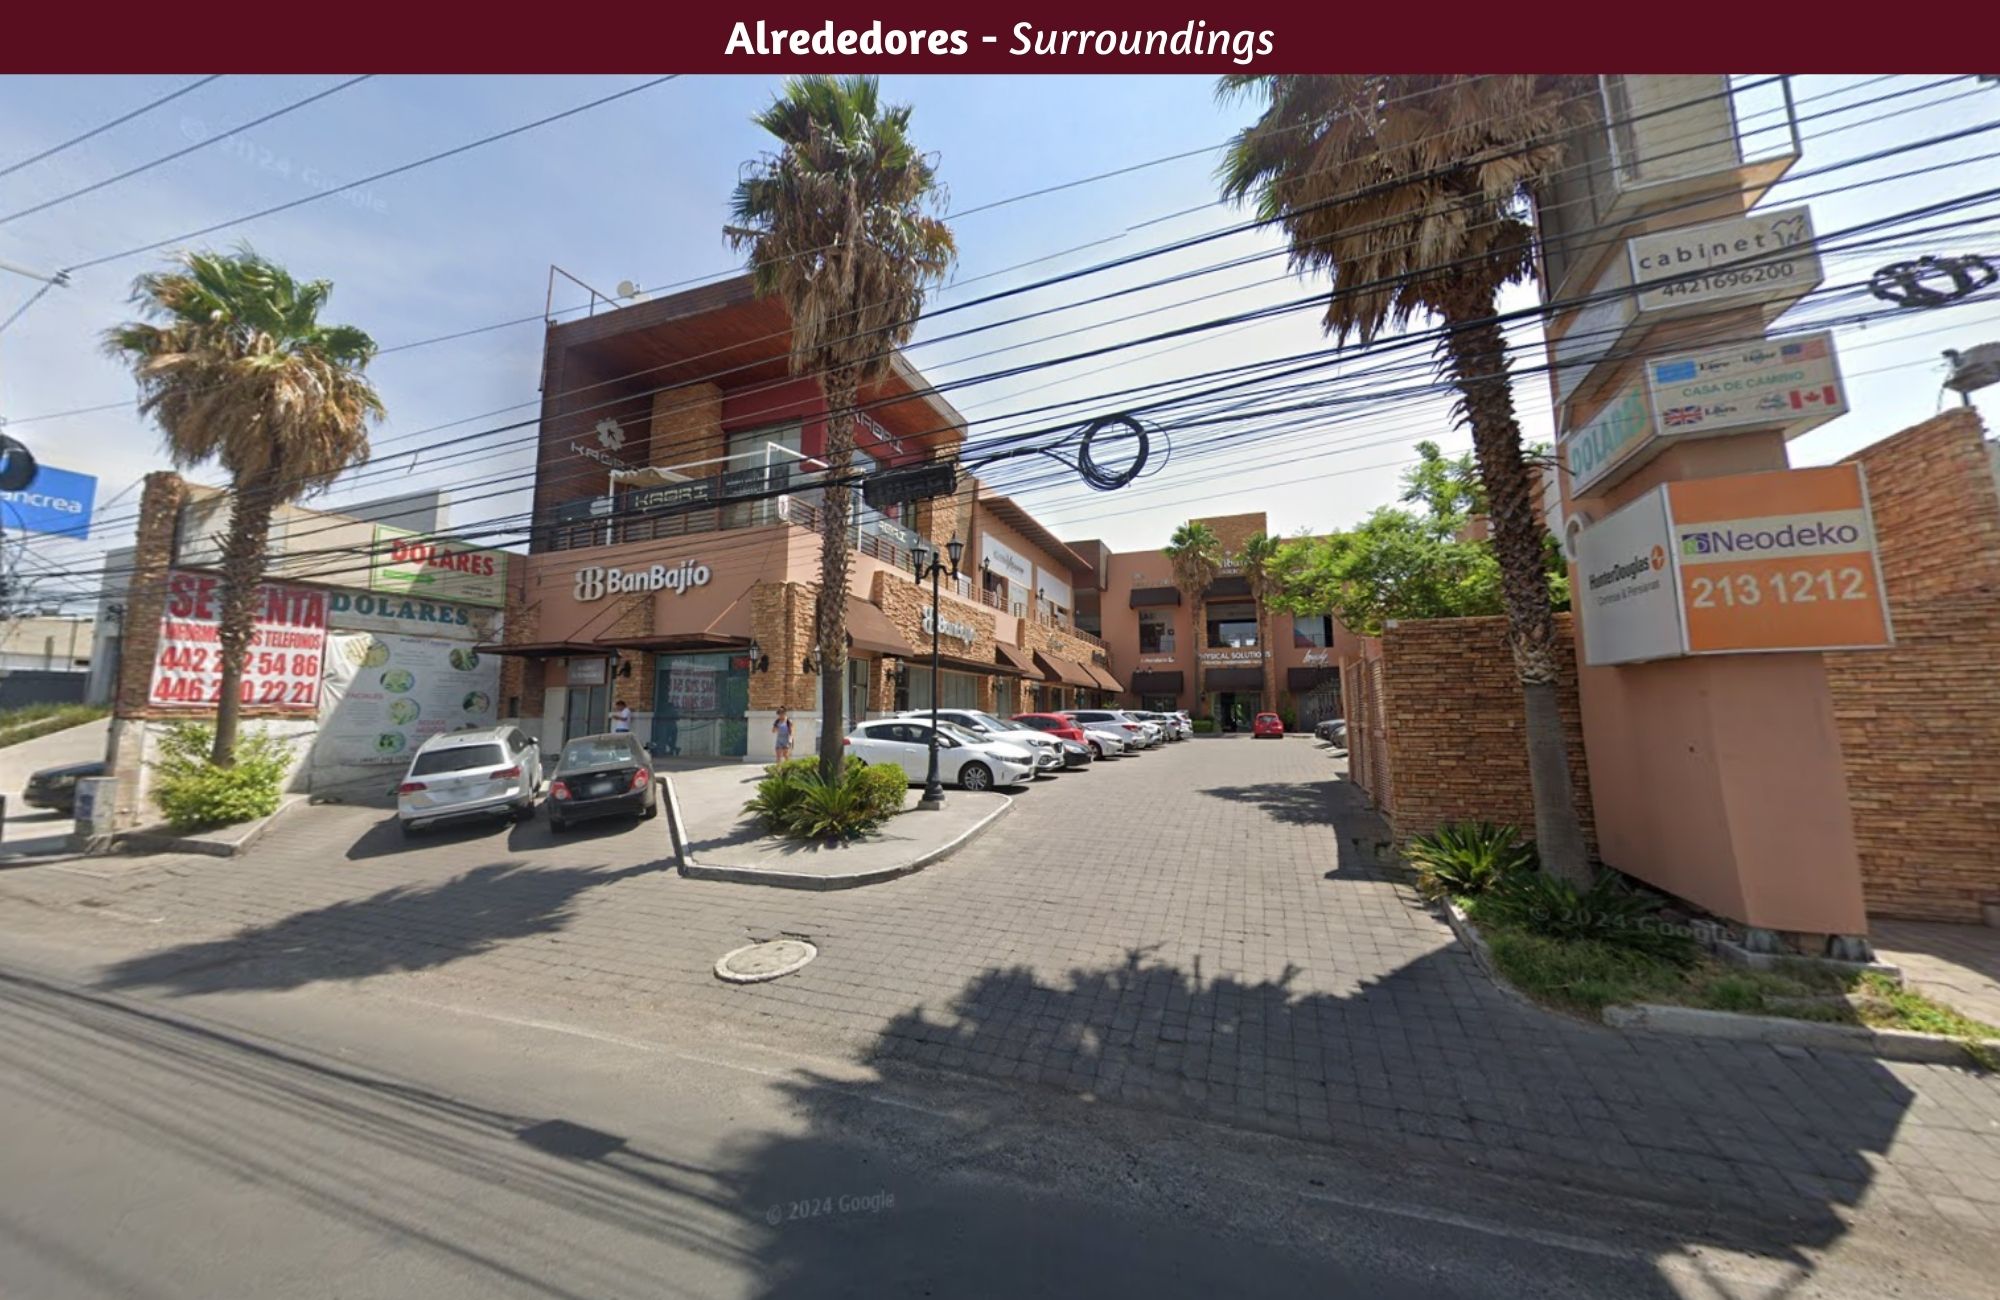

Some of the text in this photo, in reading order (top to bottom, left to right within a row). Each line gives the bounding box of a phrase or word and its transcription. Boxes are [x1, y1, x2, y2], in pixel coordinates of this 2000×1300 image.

[1639, 233, 1765, 270] cabinet
[1682, 370, 1805, 398] CASA DE CAMBIO
[1711, 522, 1859, 553] Neodeko
[391, 539, 494, 577] DOLARES
[606, 560, 710, 595] BanBajío
[1691, 567, 1867, 608] 213 1212
[169, 574, 325, 629] SE ENTA
[330, 590, 470, 626] DOLARES
[160, 645, 318, 677] 442 22 54 86
[153, 676, 315, 705] 446 20 22 21
